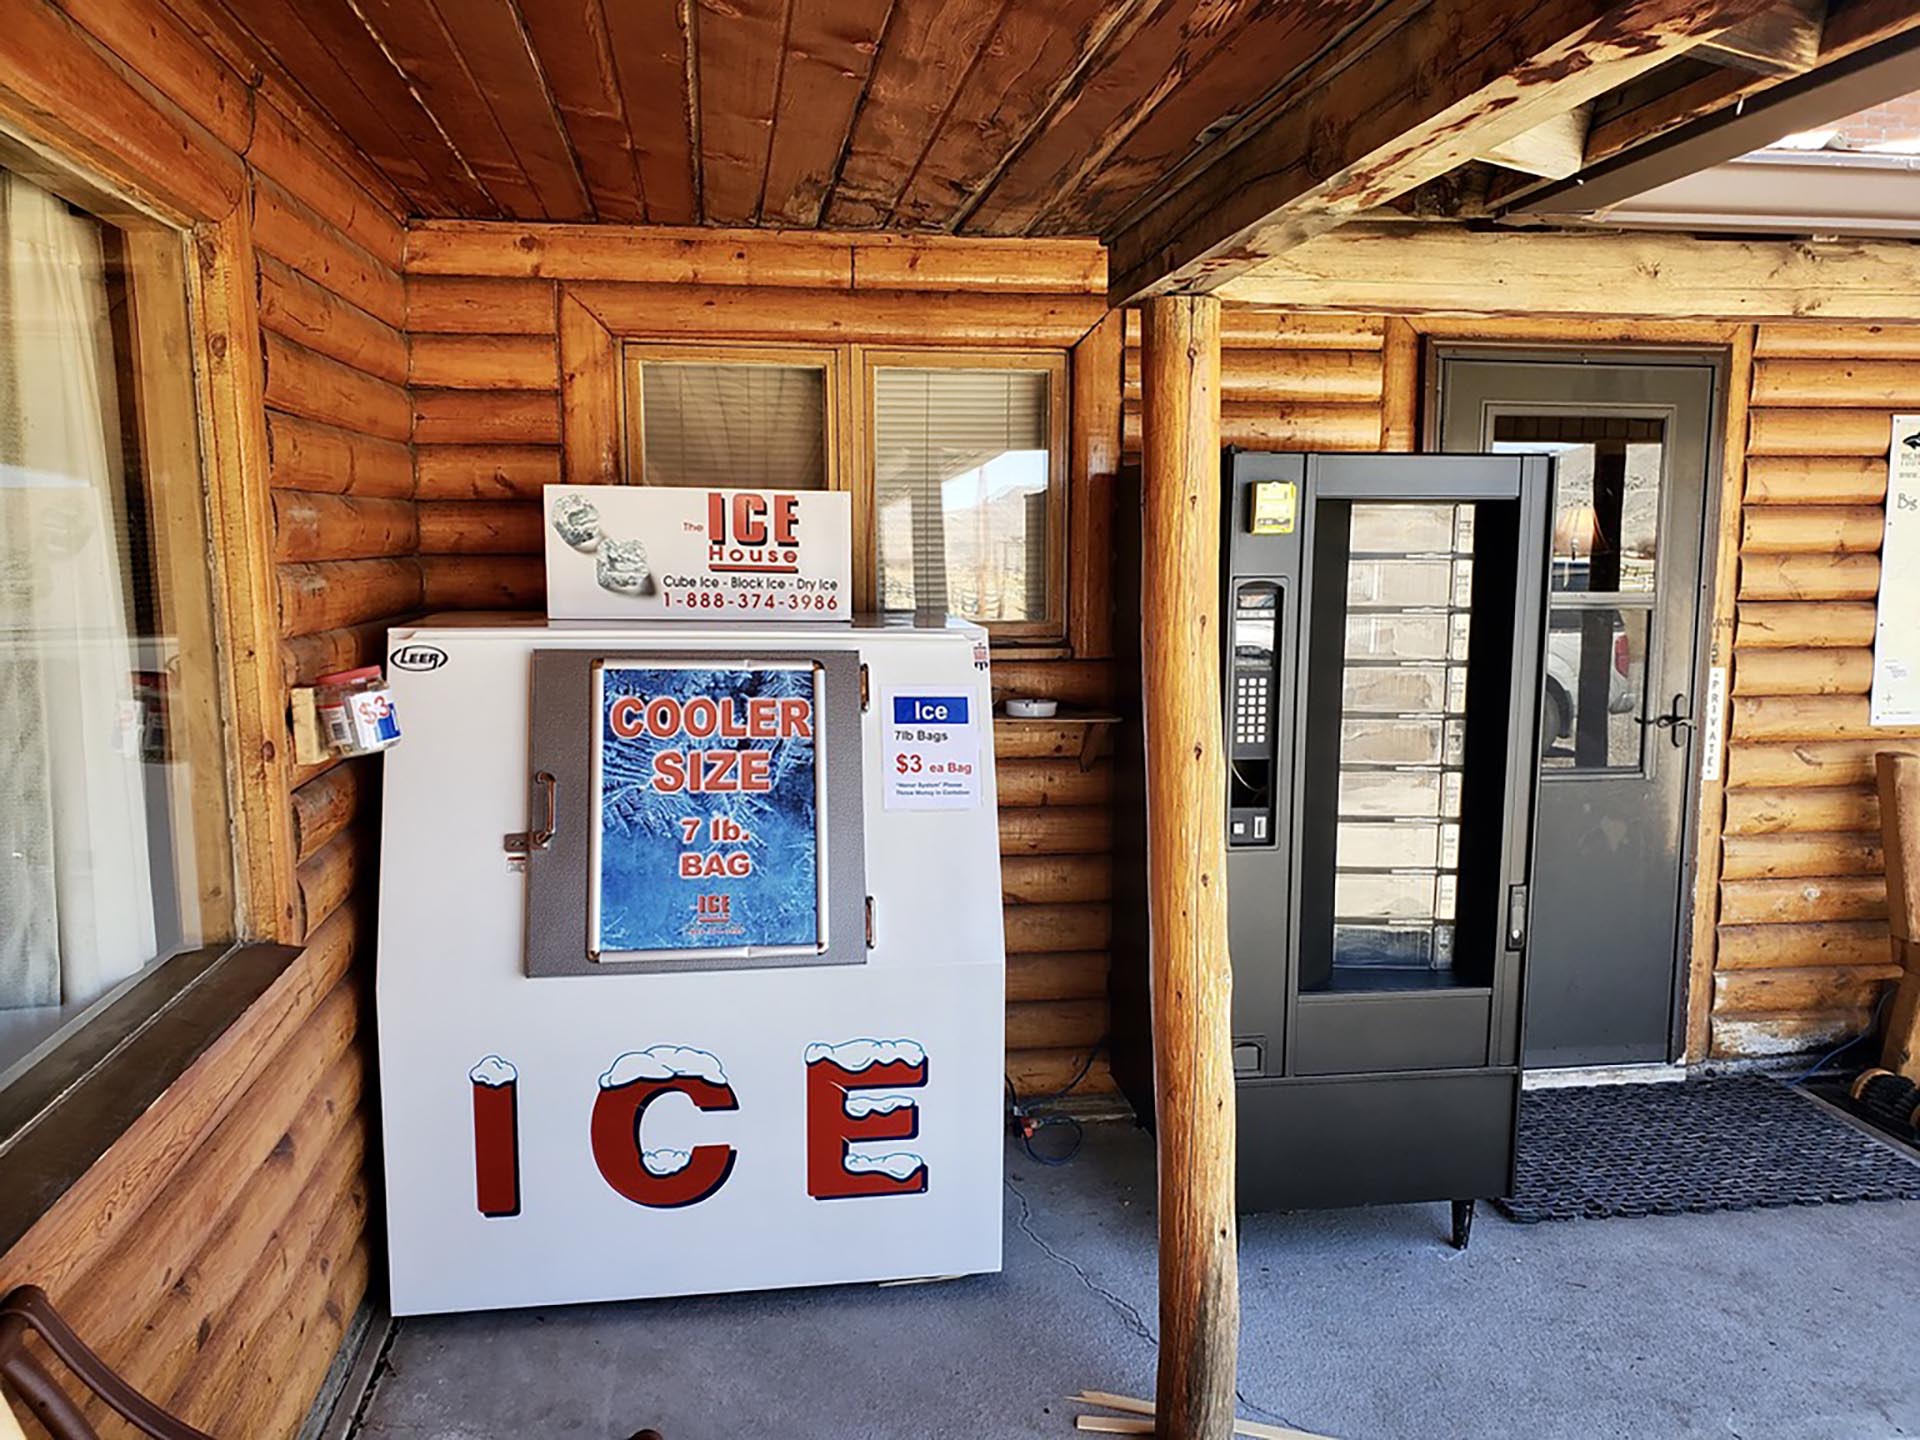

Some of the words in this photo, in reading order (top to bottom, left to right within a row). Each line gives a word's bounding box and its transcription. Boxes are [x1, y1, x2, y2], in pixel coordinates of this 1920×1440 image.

[683, 522, 704, 532] The
[708, 492, 799, 547] ICE
[709, 546, 797, 563] House
[663, 575, 696, 588] Cube
[700, 576, 719, 588] Ice
[731, 577, 766, 590] Block
[767, 578, 785, 590] Ice
[797, 579, 817, 592] Dry
[819, 579, 838, 590] Ice
[663, 592, 838, 610] 1-888-374-3986
[359, 696, 389, 724] $3
[610, 697, 811, 739] COOLER
[914, 700, 948, 720] Ice
[1707, 680, 1719, 766] PRIVATE
[894, 730, 914, 741] 7lb
[917, 730, 948, 742] Bags
[652, 750, 771, 792] SIZE
[896, 753, 922, 774] $3
[930, 764, 945, 773] ea
[948, 762, 972, 774] Bag
[681, 818, 700, 843] 7
[711, 818, 750, 843] lb.
[680, 853, 751, 878] BAG
[698, 895, 730, 913] ICE
[469, 1040, 928, 1218] ICE
